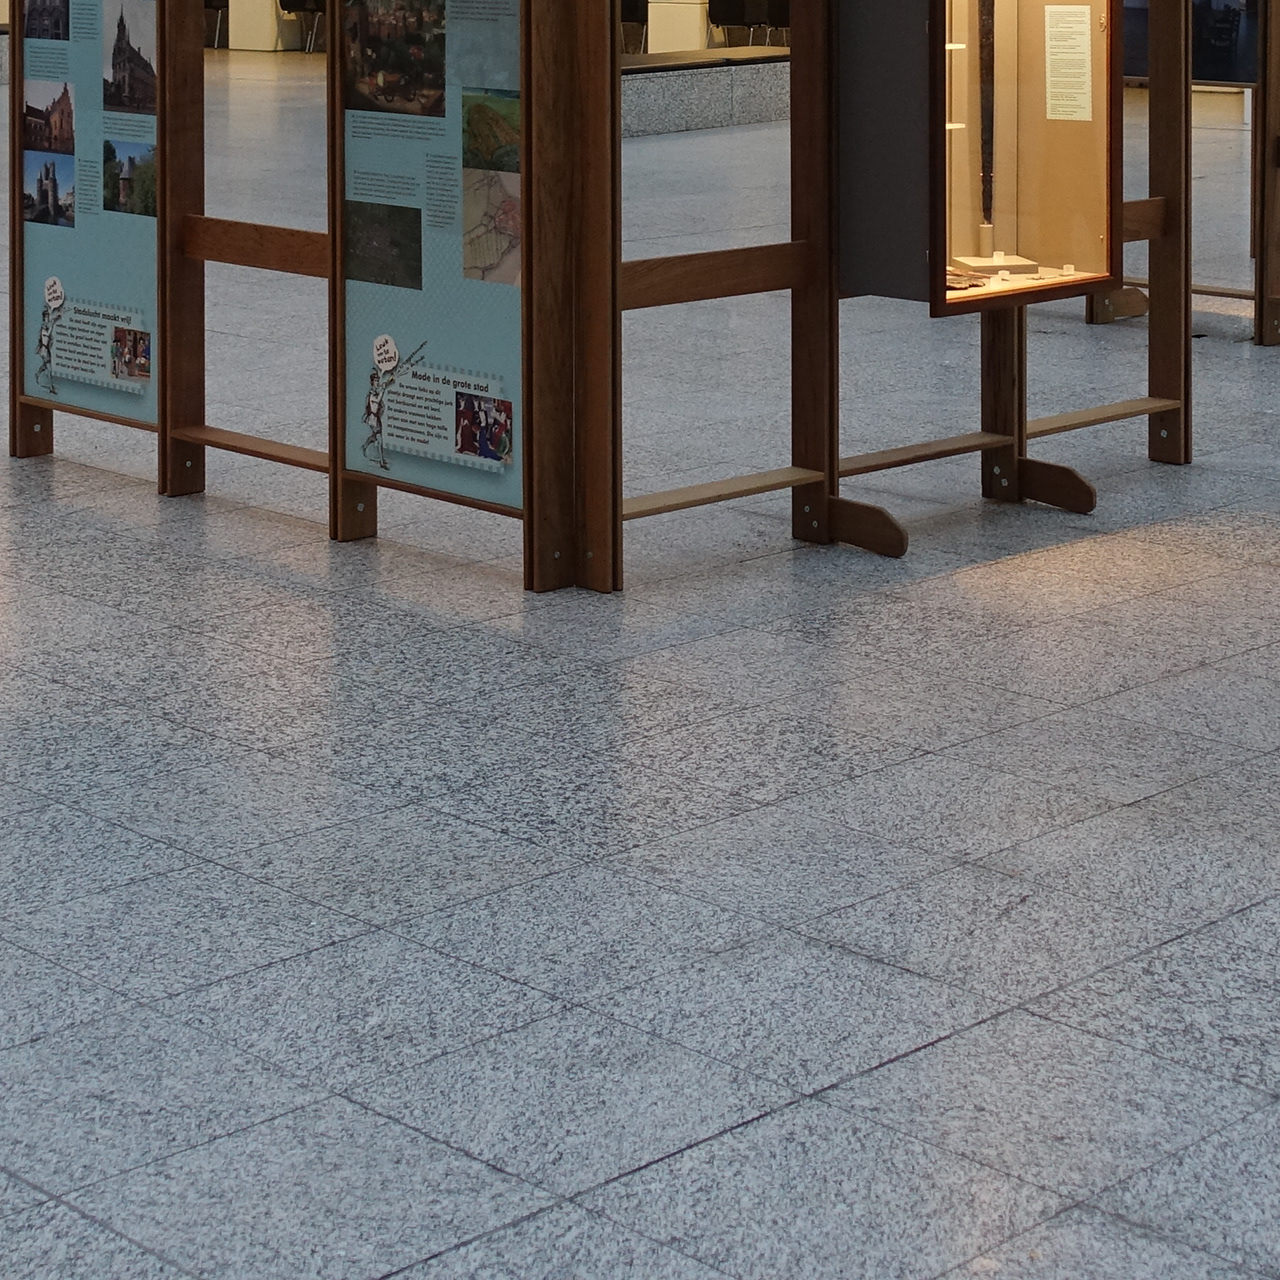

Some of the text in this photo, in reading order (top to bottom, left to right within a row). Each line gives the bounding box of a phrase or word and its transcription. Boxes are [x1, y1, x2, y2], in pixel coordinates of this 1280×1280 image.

[376, 339, 388, 351] Leuk
[378, 352, 396, 364] weten!
[412, 371, 488, 392] Mode in de grote stad
